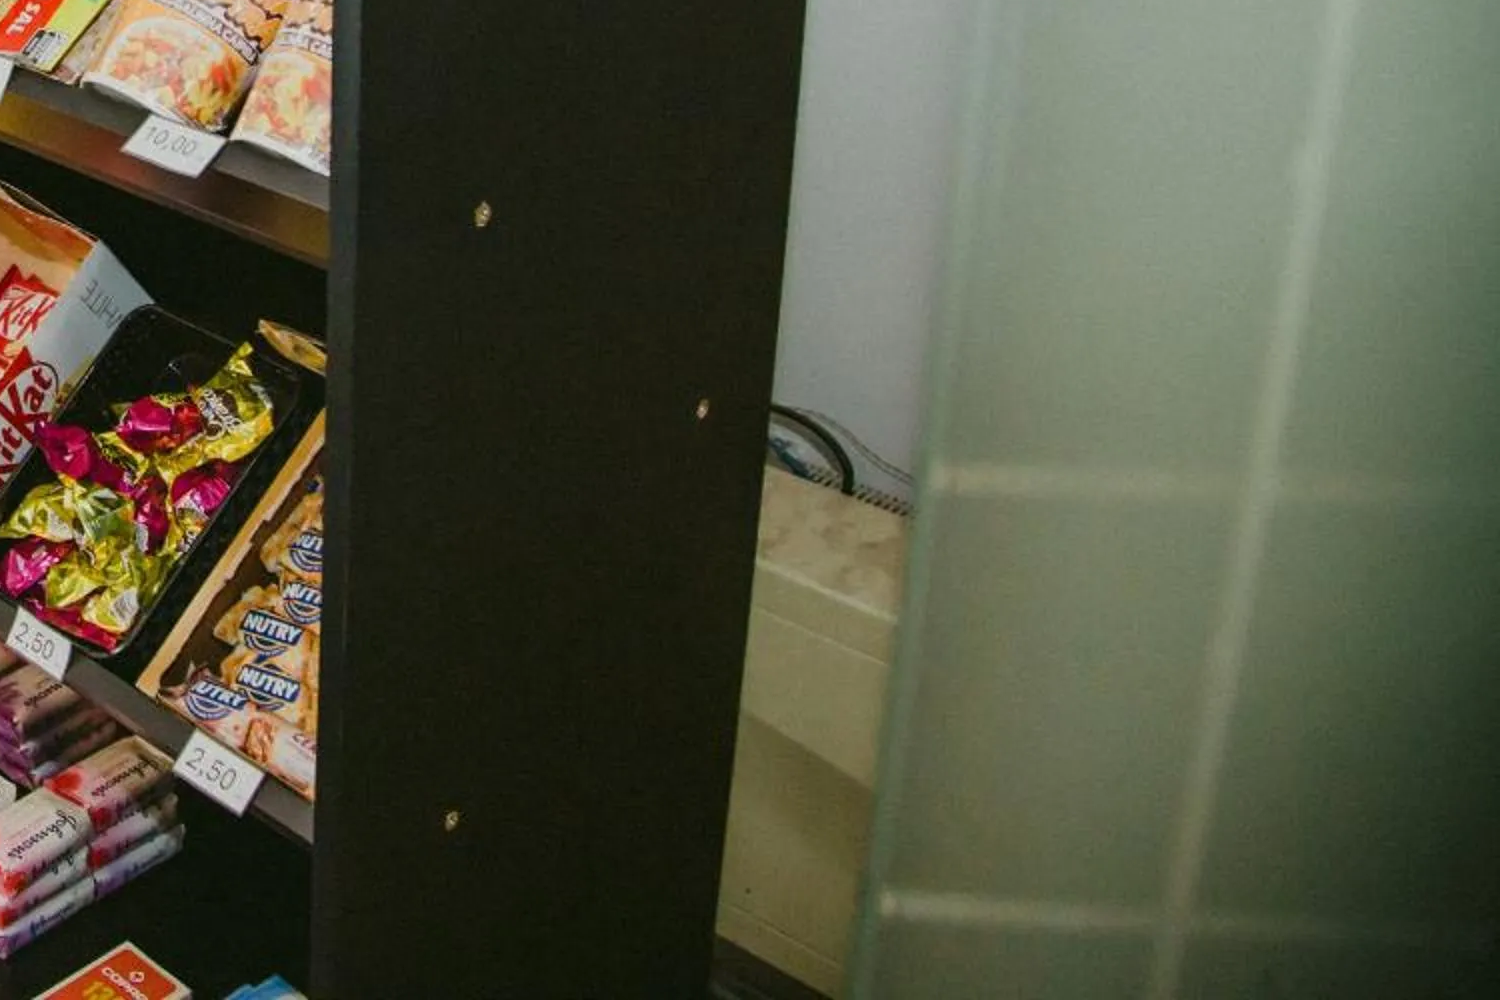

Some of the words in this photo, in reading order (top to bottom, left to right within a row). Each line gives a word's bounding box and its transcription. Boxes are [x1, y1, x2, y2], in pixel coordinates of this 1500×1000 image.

[7, 1, 42, 36] SAL
[143, 124, 198, 157] 10,00
[14, 622, 56, 660] 2,50
[245, 612, 301, 643] NUTRY
[240, 667, 298, 699] NUTRY
[185, 747, 237, 792] 2,50
